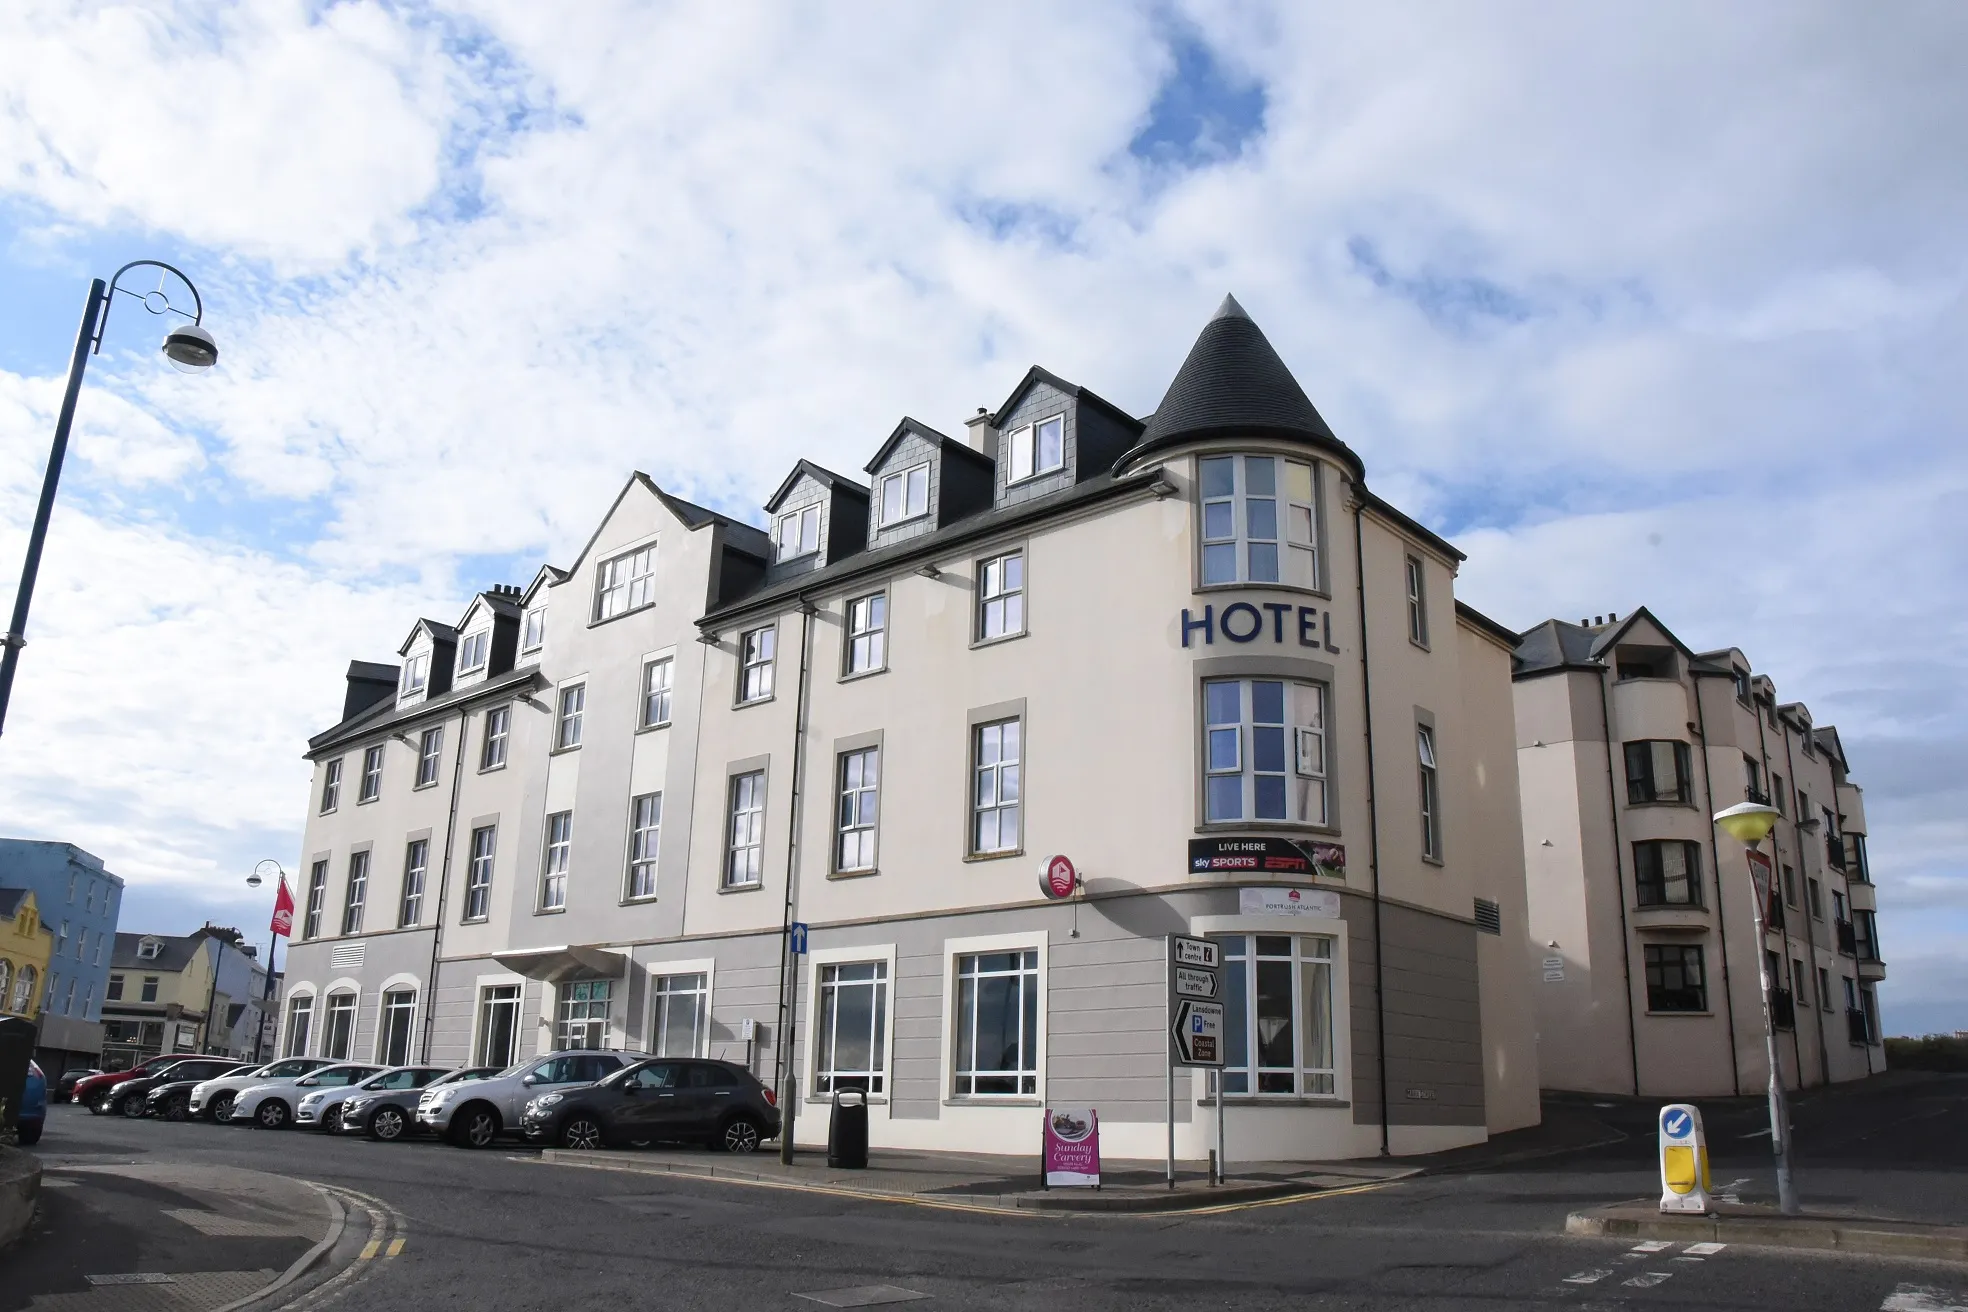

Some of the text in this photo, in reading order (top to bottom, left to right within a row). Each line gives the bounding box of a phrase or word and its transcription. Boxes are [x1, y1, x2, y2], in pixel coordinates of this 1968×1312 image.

[1181, 602, 1340, 654] HOTEL
[1218, 843, 1266, 851] LIVE HERE
[1194, 857, 1256, 869] sky SPORTS
[1265, 903, 1296, 911] PORTRUSH
[1186, 942, 1200, 952] Town
[1184, 952, 1202, 962] centre
[1178, 972, 1209, 983] All through
[1186, 983, 1202, 992] traffic
[1192, 1004, 1221, 1015] Lansdowne
[1204, 1020, 1215, 1029] Free
[1194, 1038, 1215, 1048] Coastal
[1198, 1048, 1211, 1058] Zone
[1055, 1142, 1092, 1154] Sunday
[1053, 1152, 1092, 1164] Carvery
